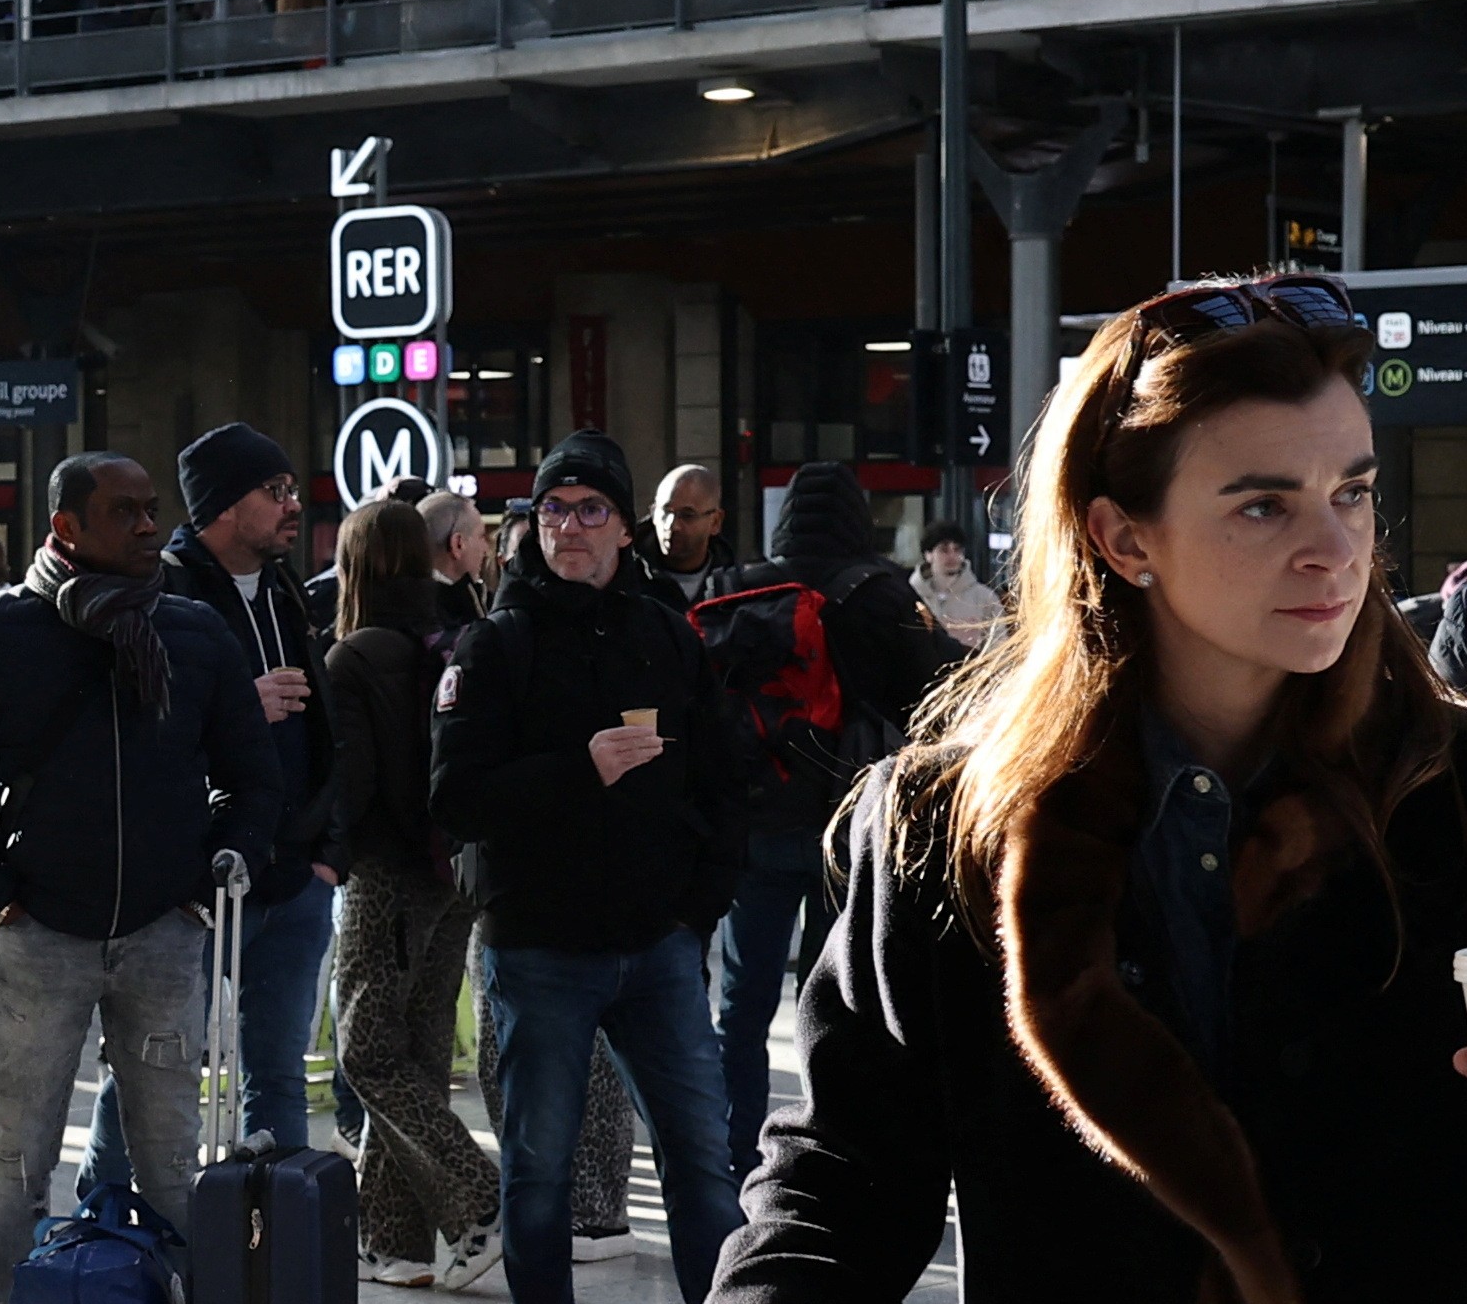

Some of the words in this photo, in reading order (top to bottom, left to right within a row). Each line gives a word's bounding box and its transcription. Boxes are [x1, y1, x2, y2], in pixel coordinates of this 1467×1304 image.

[346, 246, 420, 299] RER
[1417, 320, 1463, 335] Niveau
[375, 351, 394, 376] D
[413, 348, 428, 373] E
[1417, 366, 1463, 383] Niveau
[11, 382, 68, 406] groupe
[360, 427, 411, 496] M
